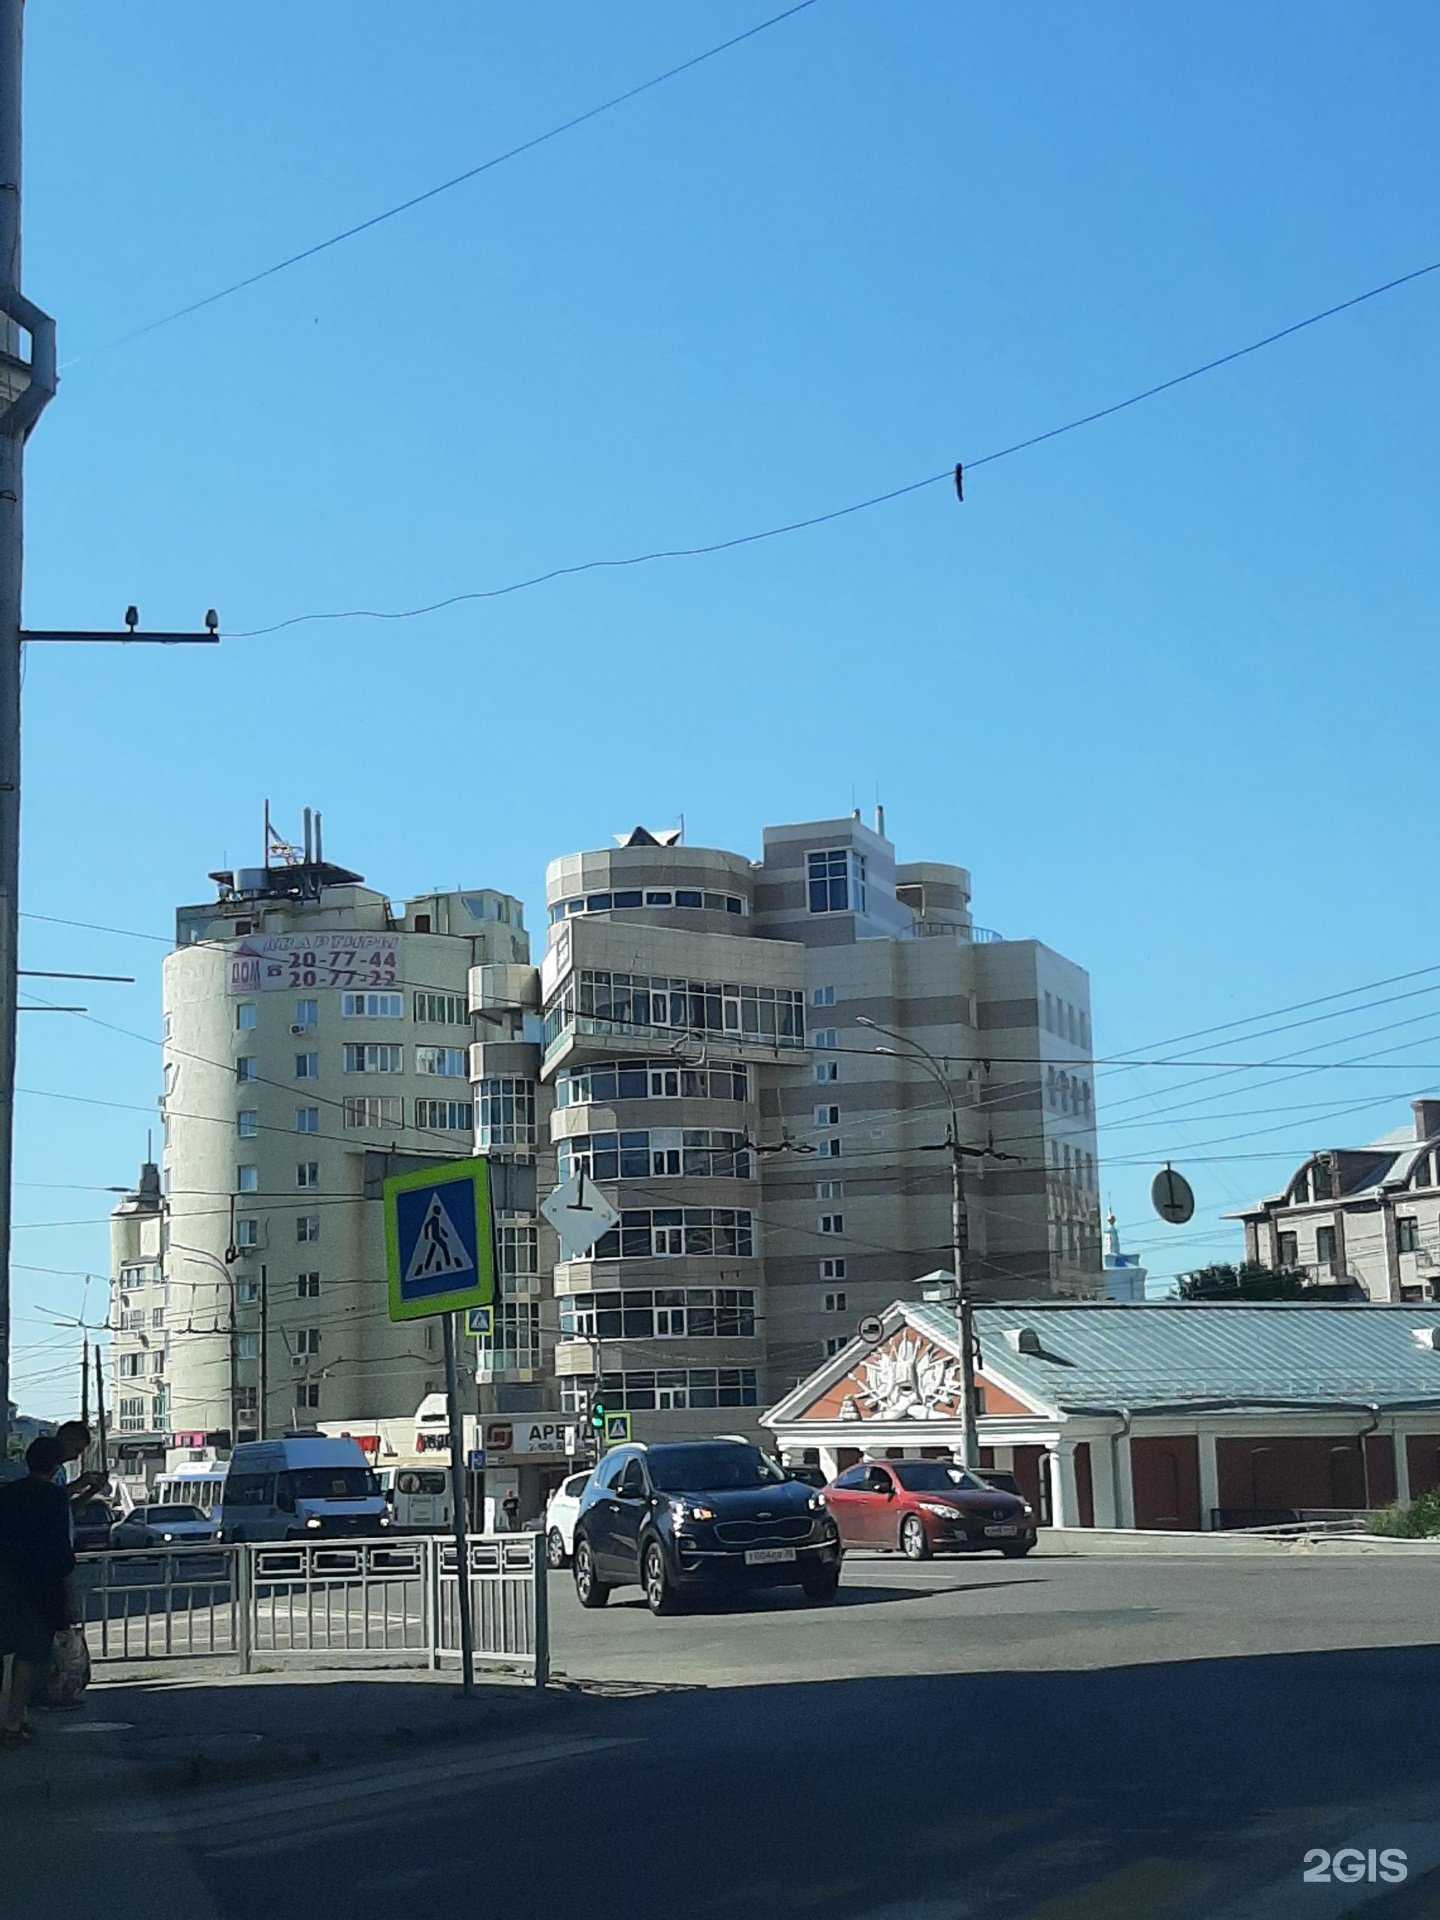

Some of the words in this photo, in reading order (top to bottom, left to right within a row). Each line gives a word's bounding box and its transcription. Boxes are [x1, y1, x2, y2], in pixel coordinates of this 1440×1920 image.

[288, 951, 396, 969] 20-77-44
[231, 960, 261, 986] ДОМ
[288, 970, 396, 988] 20-77-22
